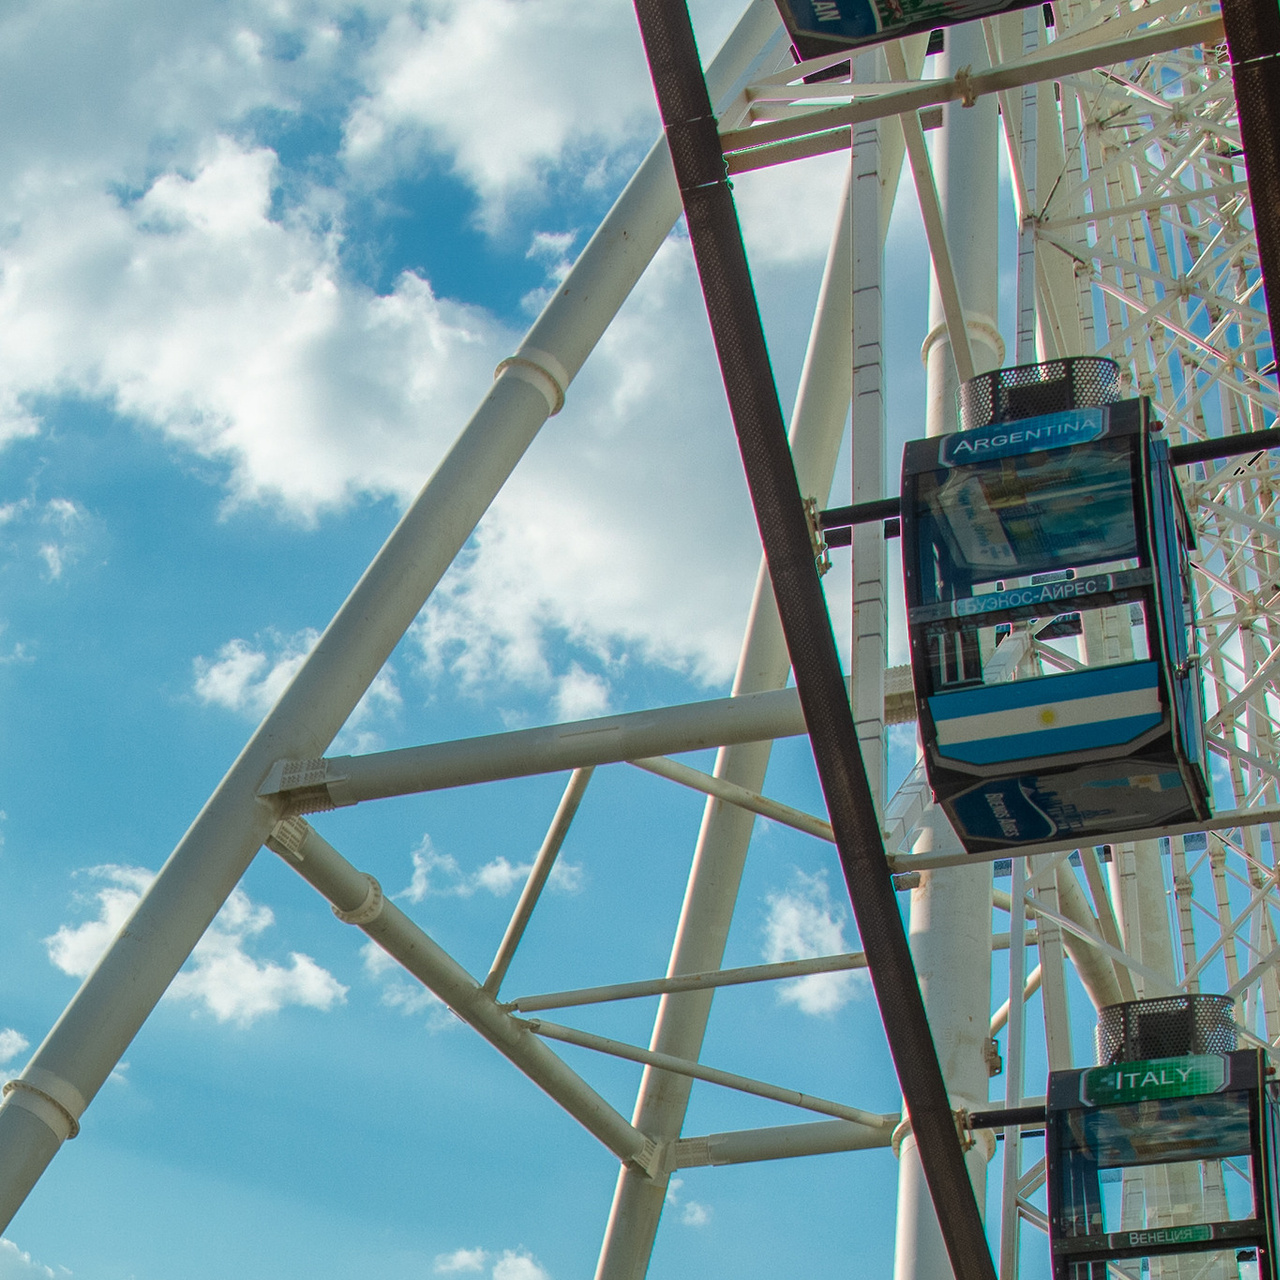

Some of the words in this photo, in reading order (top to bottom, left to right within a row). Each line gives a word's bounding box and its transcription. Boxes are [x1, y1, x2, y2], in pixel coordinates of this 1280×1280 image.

[953, 419, 1096, 454] ARGENTINA
[964, 580, 1097, 613] БУЭНОС-АЙРЕС
[1116, 1067, 1193, 1090] ITALY
[1129, 1228, 1193, 1245] ВЕНЕЦИЯ
